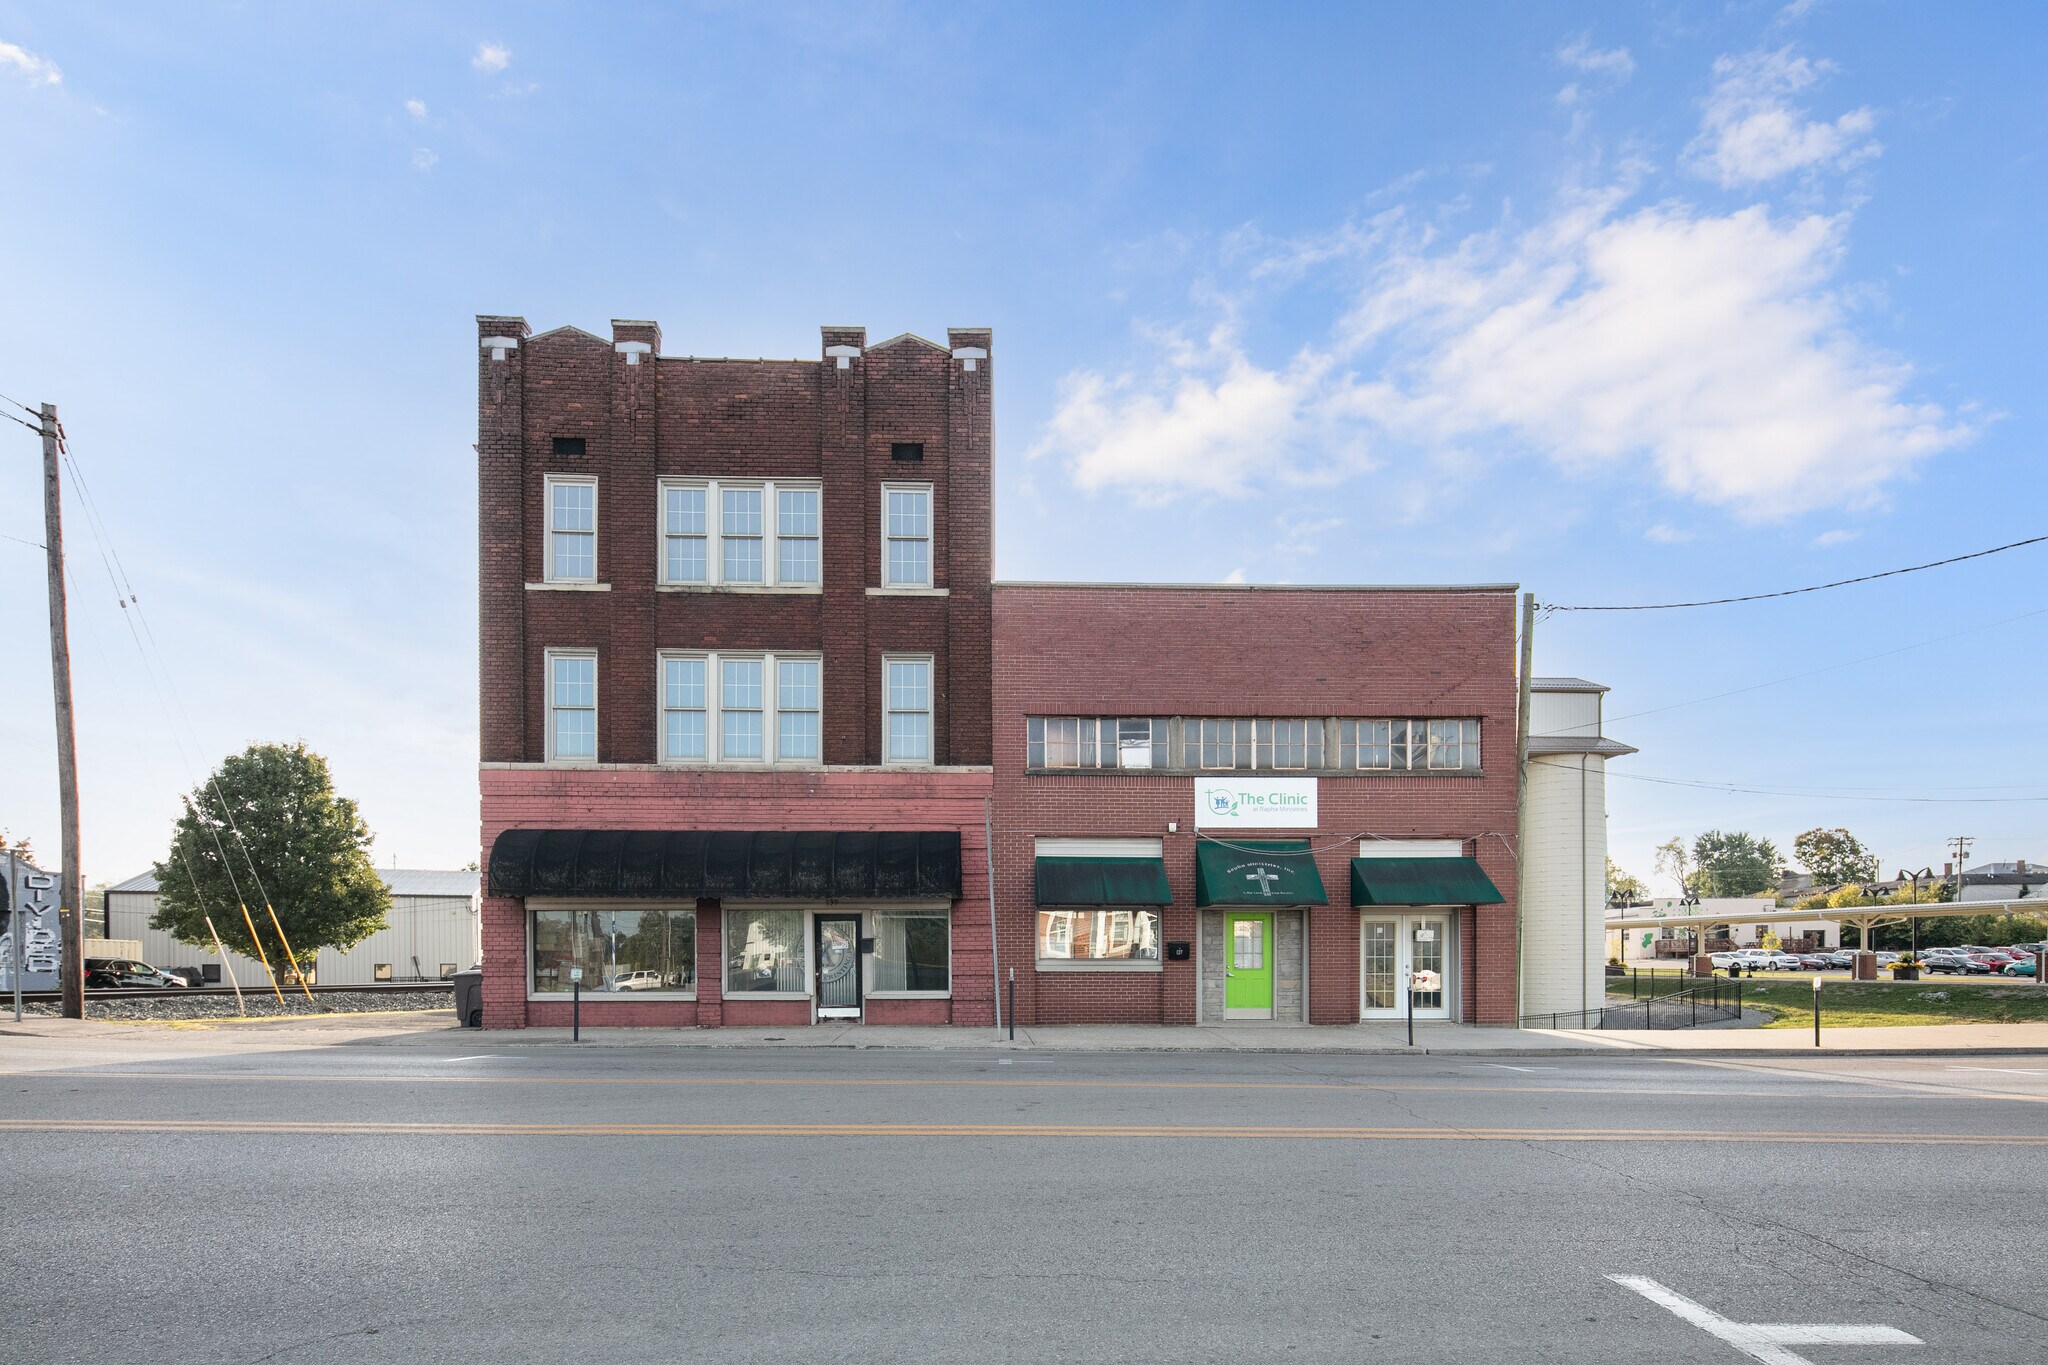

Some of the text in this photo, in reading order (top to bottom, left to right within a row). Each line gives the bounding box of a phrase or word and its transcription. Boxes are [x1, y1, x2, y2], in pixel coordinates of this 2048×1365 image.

[1238, 792, 1308, 805] The Clinic
[826, 898, 839, 906] 139
